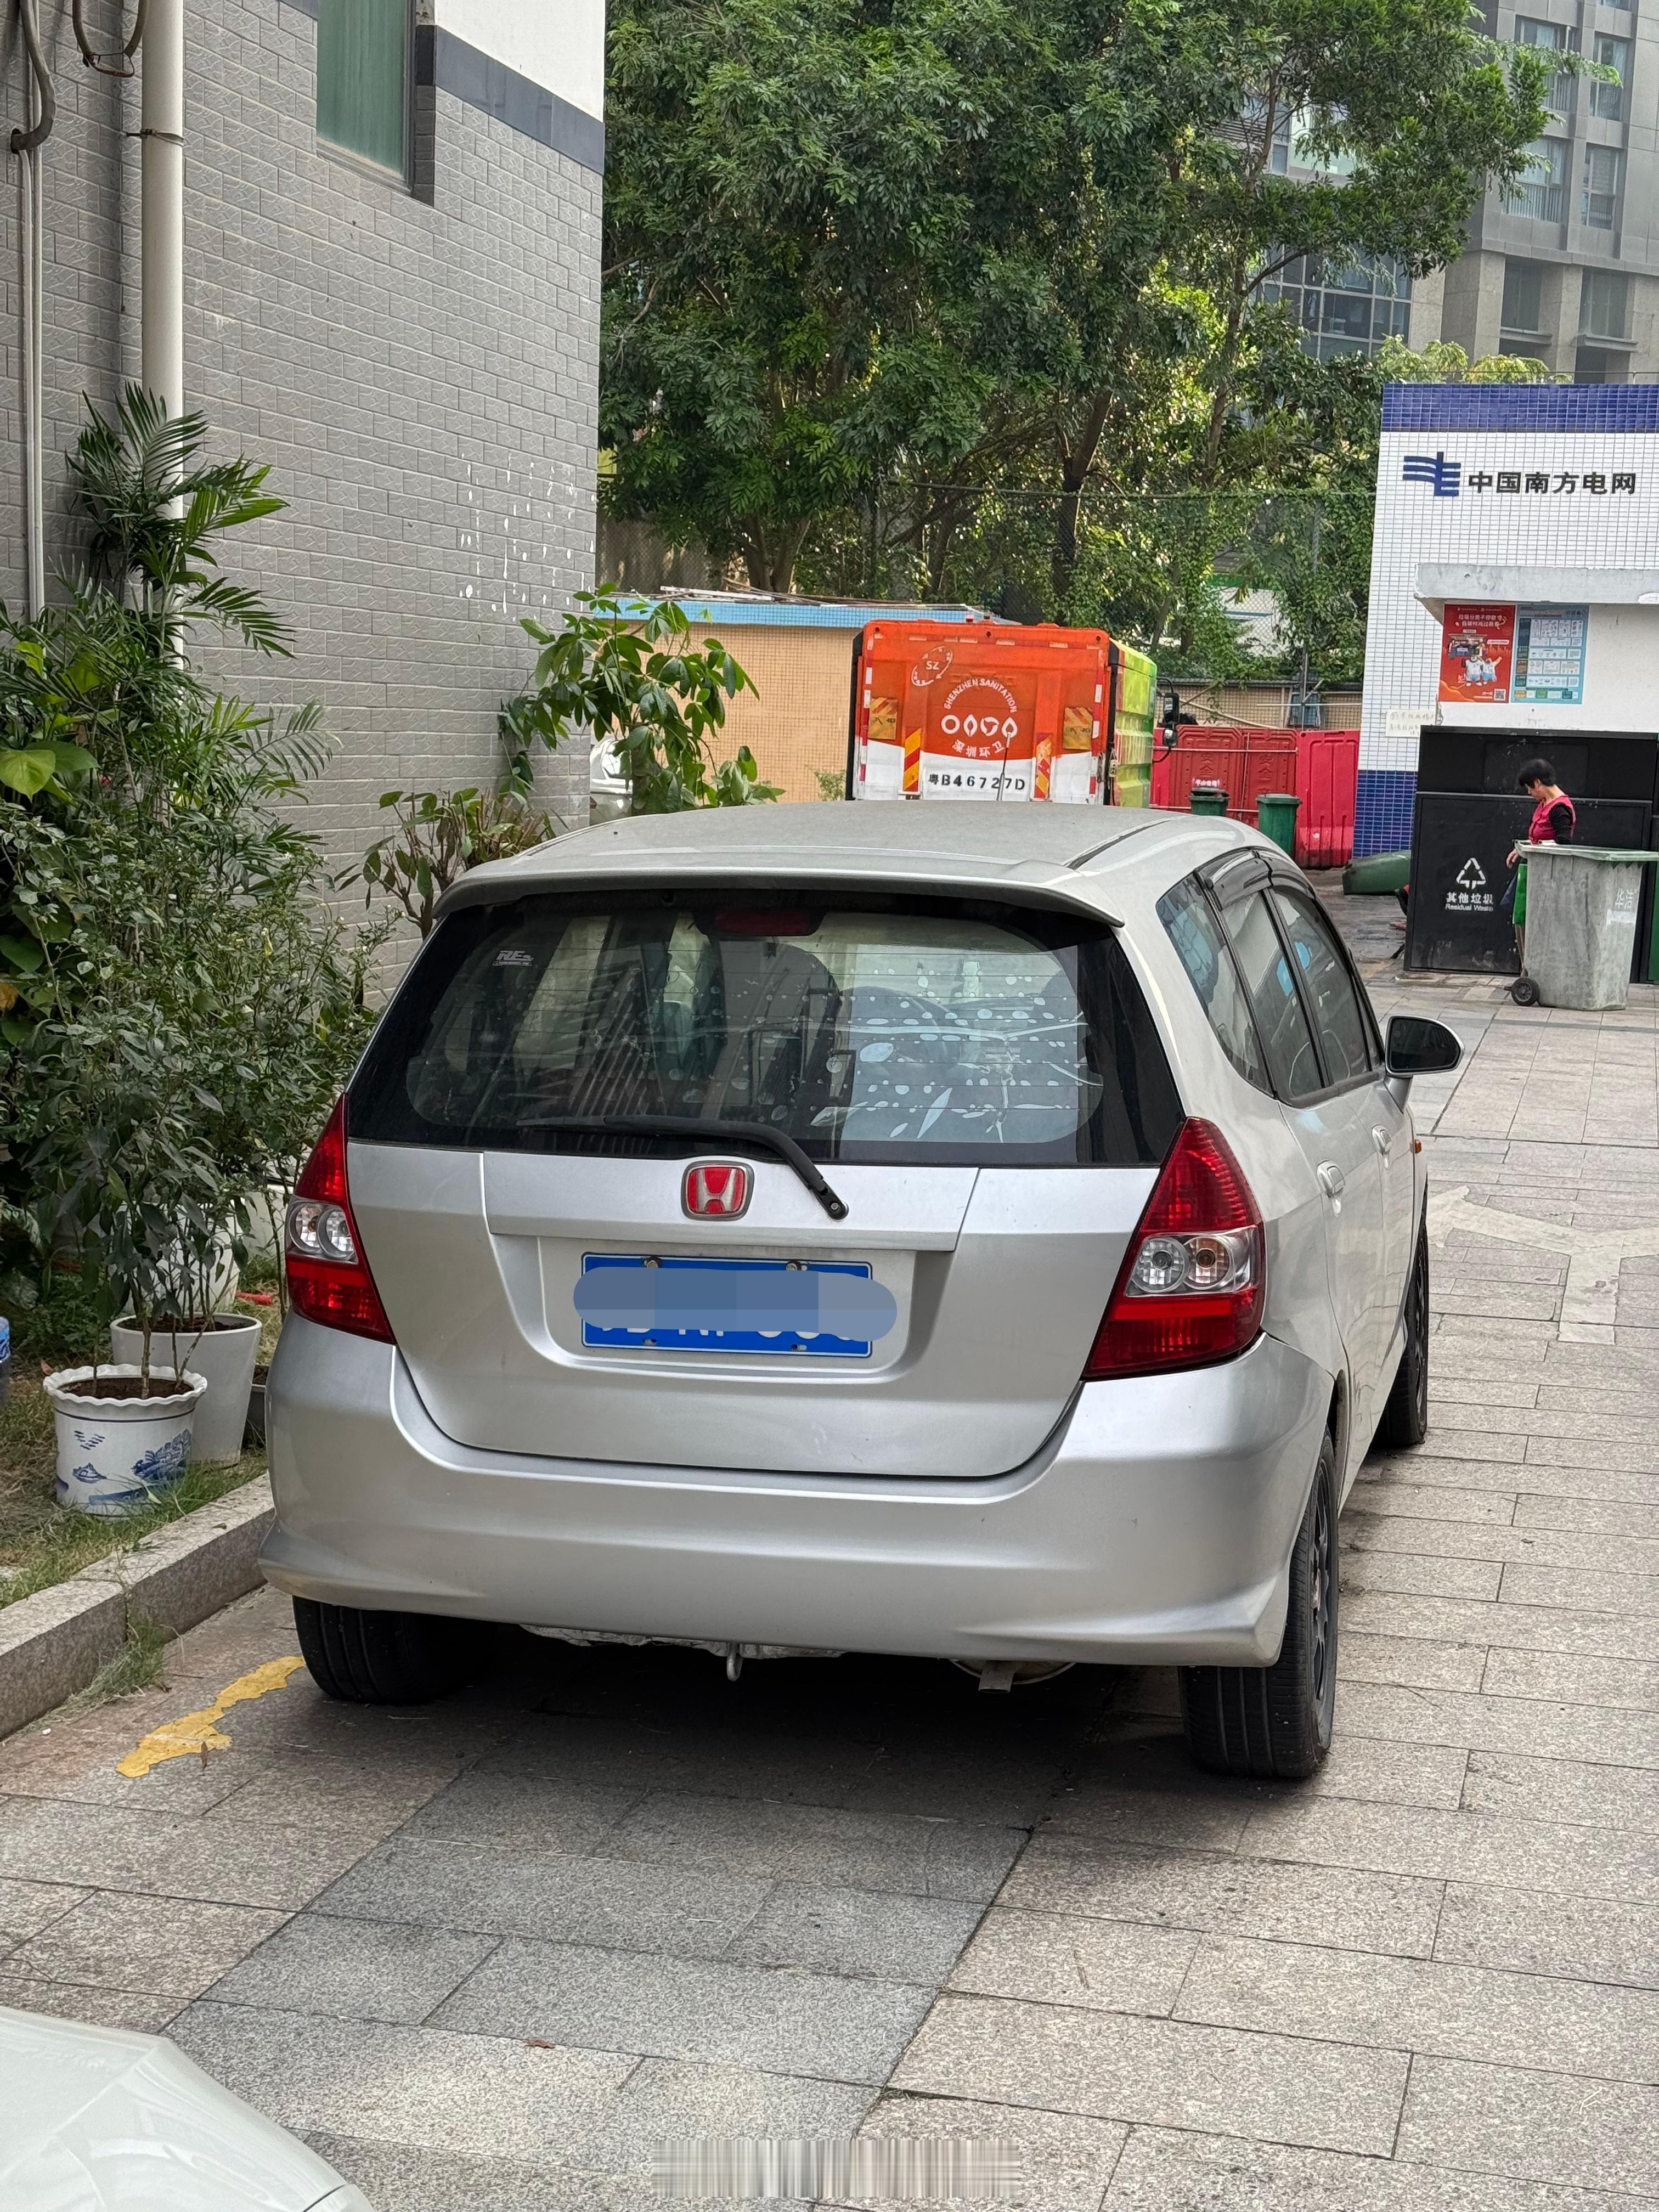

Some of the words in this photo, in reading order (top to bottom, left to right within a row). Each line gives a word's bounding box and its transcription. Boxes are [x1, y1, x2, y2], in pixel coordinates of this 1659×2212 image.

[1469, 471, 1637, 494] 中国南方电网
[926, 660, 939, 670] SZ
[944, 678, 978, 709] SHENZHEN
[979, 678, 1017, 713] SANITATION
[952, 739, 1005, 758] 深圳环卫
[928, 774, 1025, 790] 粤B46727D
[1446, 892, 1493, 905] 其他垃圾
